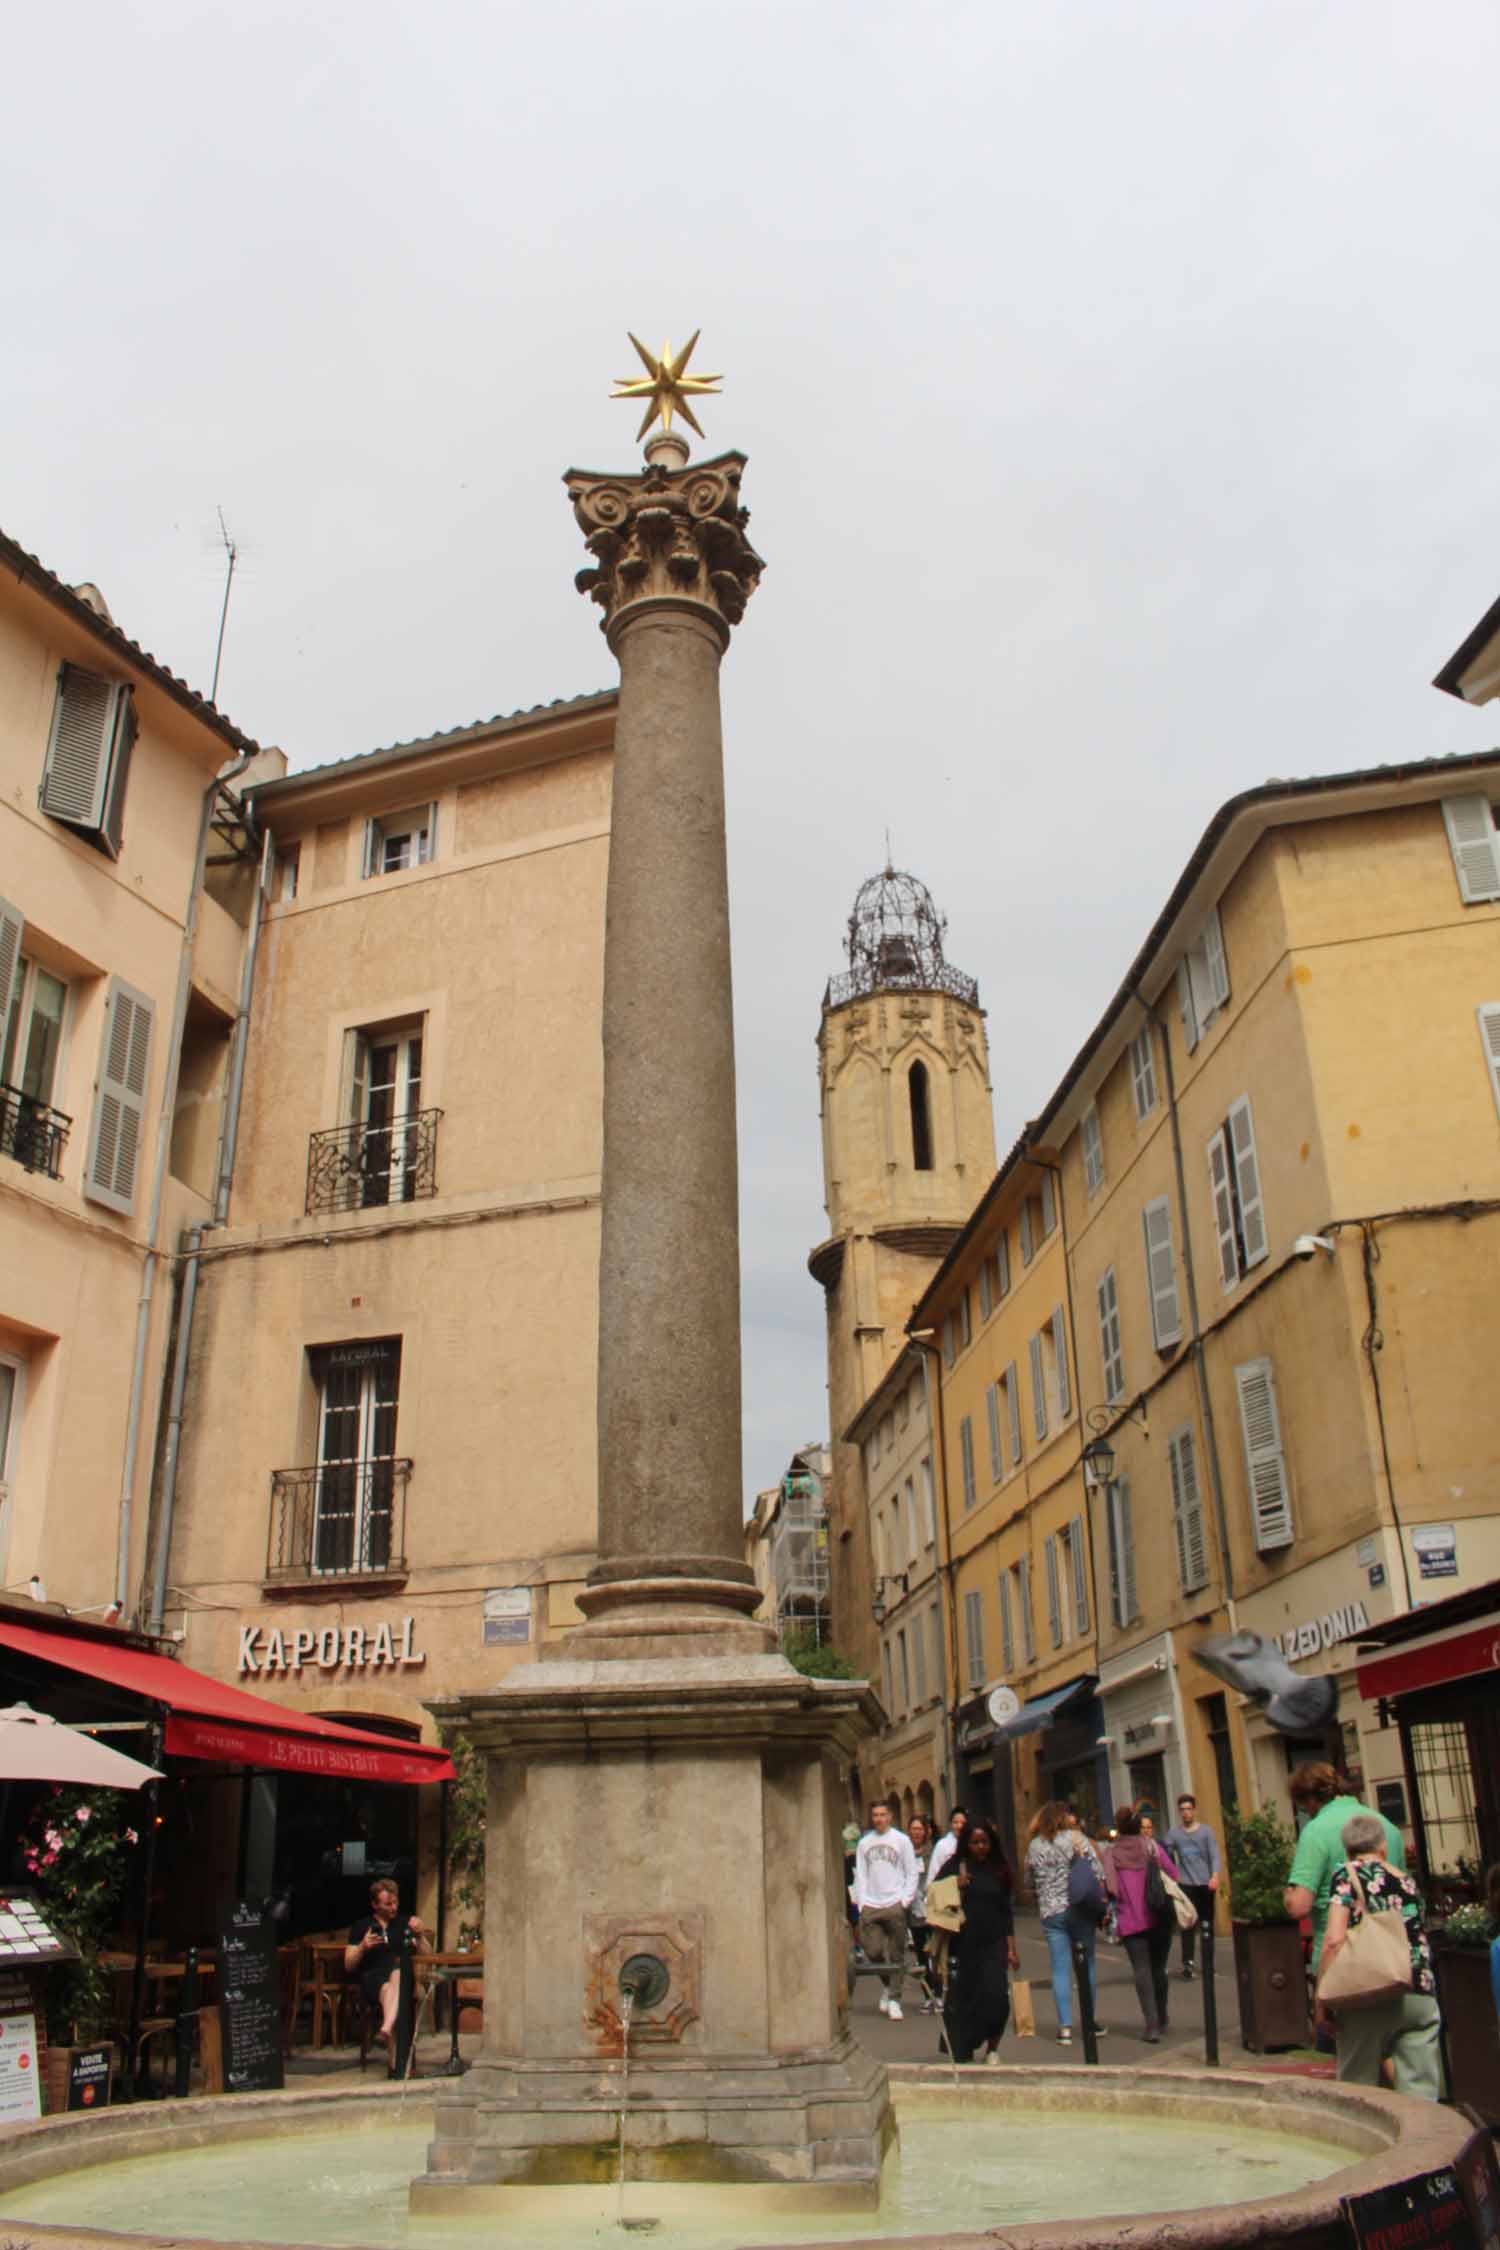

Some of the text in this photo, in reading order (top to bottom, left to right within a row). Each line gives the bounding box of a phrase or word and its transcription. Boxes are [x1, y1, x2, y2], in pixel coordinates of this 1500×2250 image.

[238, 1615, 426, 1672] KAPORAL
[269, 1739, 287, 1761] LE
[288, 1743, 325, 1767] PETIT
